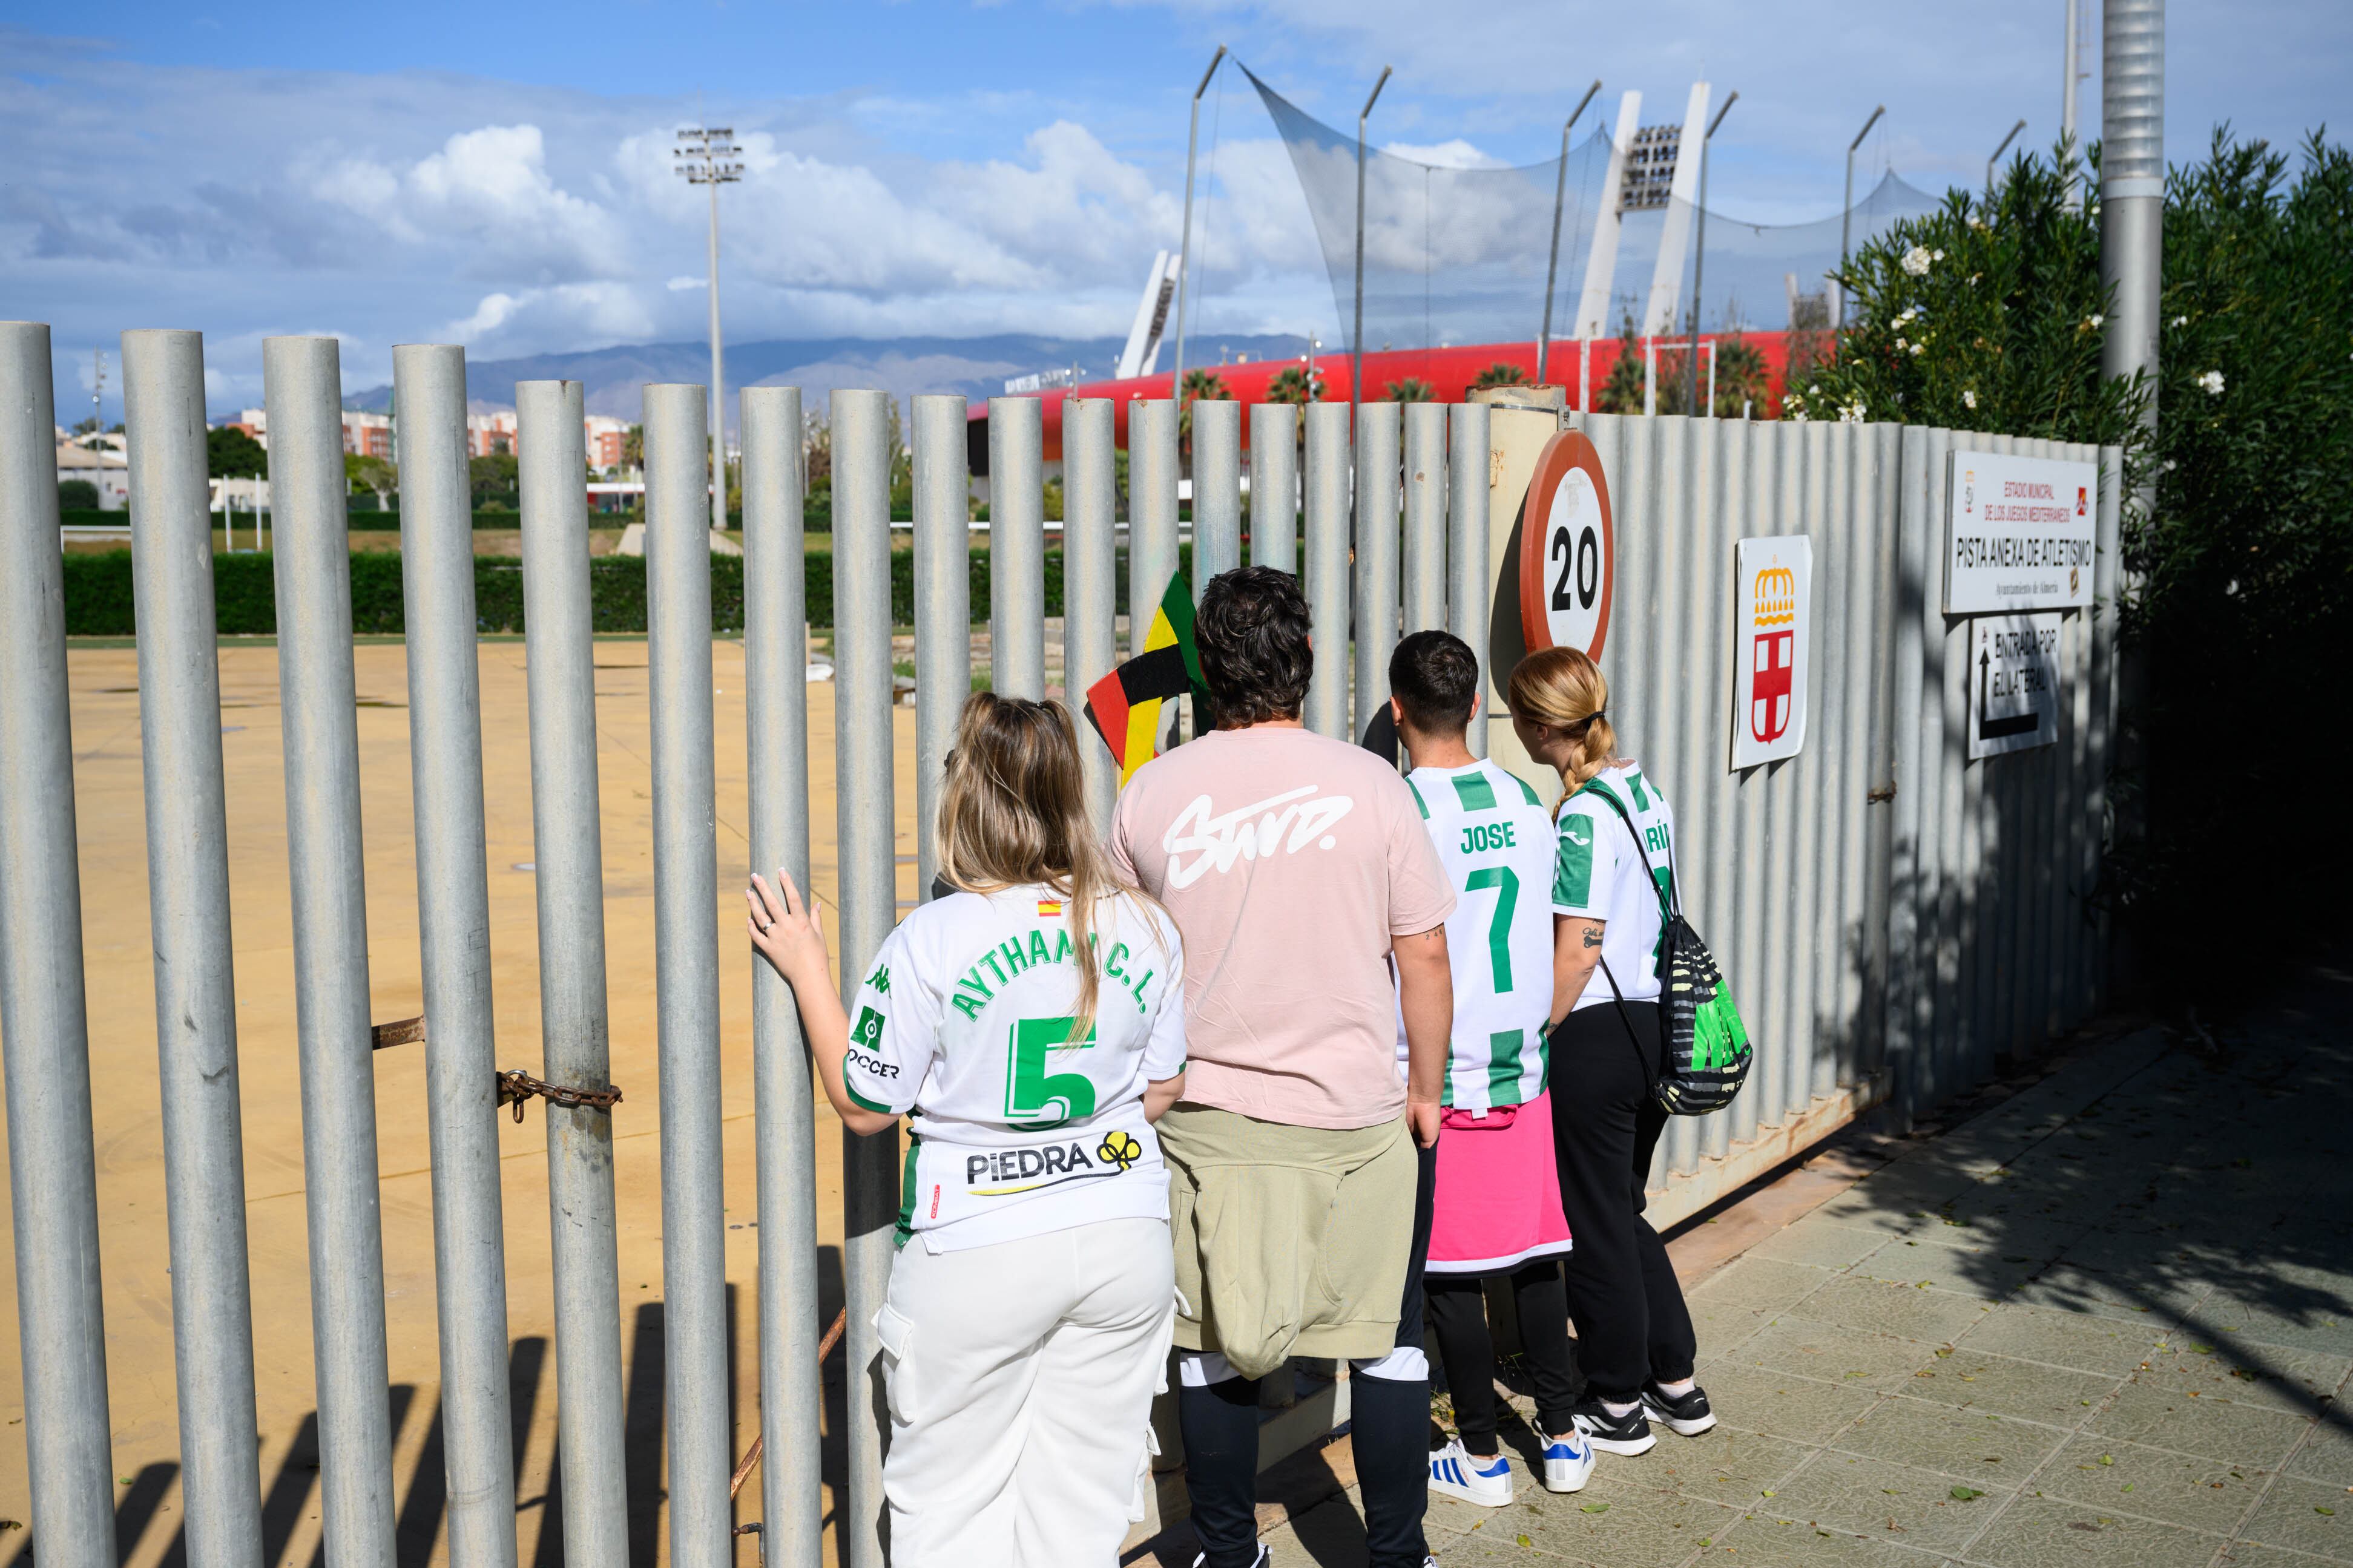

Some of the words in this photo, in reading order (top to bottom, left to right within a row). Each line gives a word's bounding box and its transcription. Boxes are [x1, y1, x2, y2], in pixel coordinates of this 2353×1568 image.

[2005, 482, 2027, 497] ESTADIO
[2029, 483, 2054, 499] MUNICIPAL
[1985, 504, 1993, 520] DE
[1994, 505, 2005, 521] LOS
[2006, 505, 2027, 521] JUEGOS
[1957, 537, 1987, 568] PISTA
[1989, 537, 2025, 567] ANEXA
[2027, 538, 2040, 566] DE
[2041, 539, 2091, 566] ATLETISMO
[1552, 526, 1598, 612] 20
[1995, 632, 2041, 658] ENTRADA
[2039, 629, 2057, 654] POR
[1995, 672, 2006, 697] EL
[2008, 667, 2046, 695] LATERAL
[1461, 821, 1516, 854] JOSE
[1642, 819, 1670, 853] RÍ
[1465, 866, 1519, 993] 7
[1004, 1016, 1096, 1132] 5
